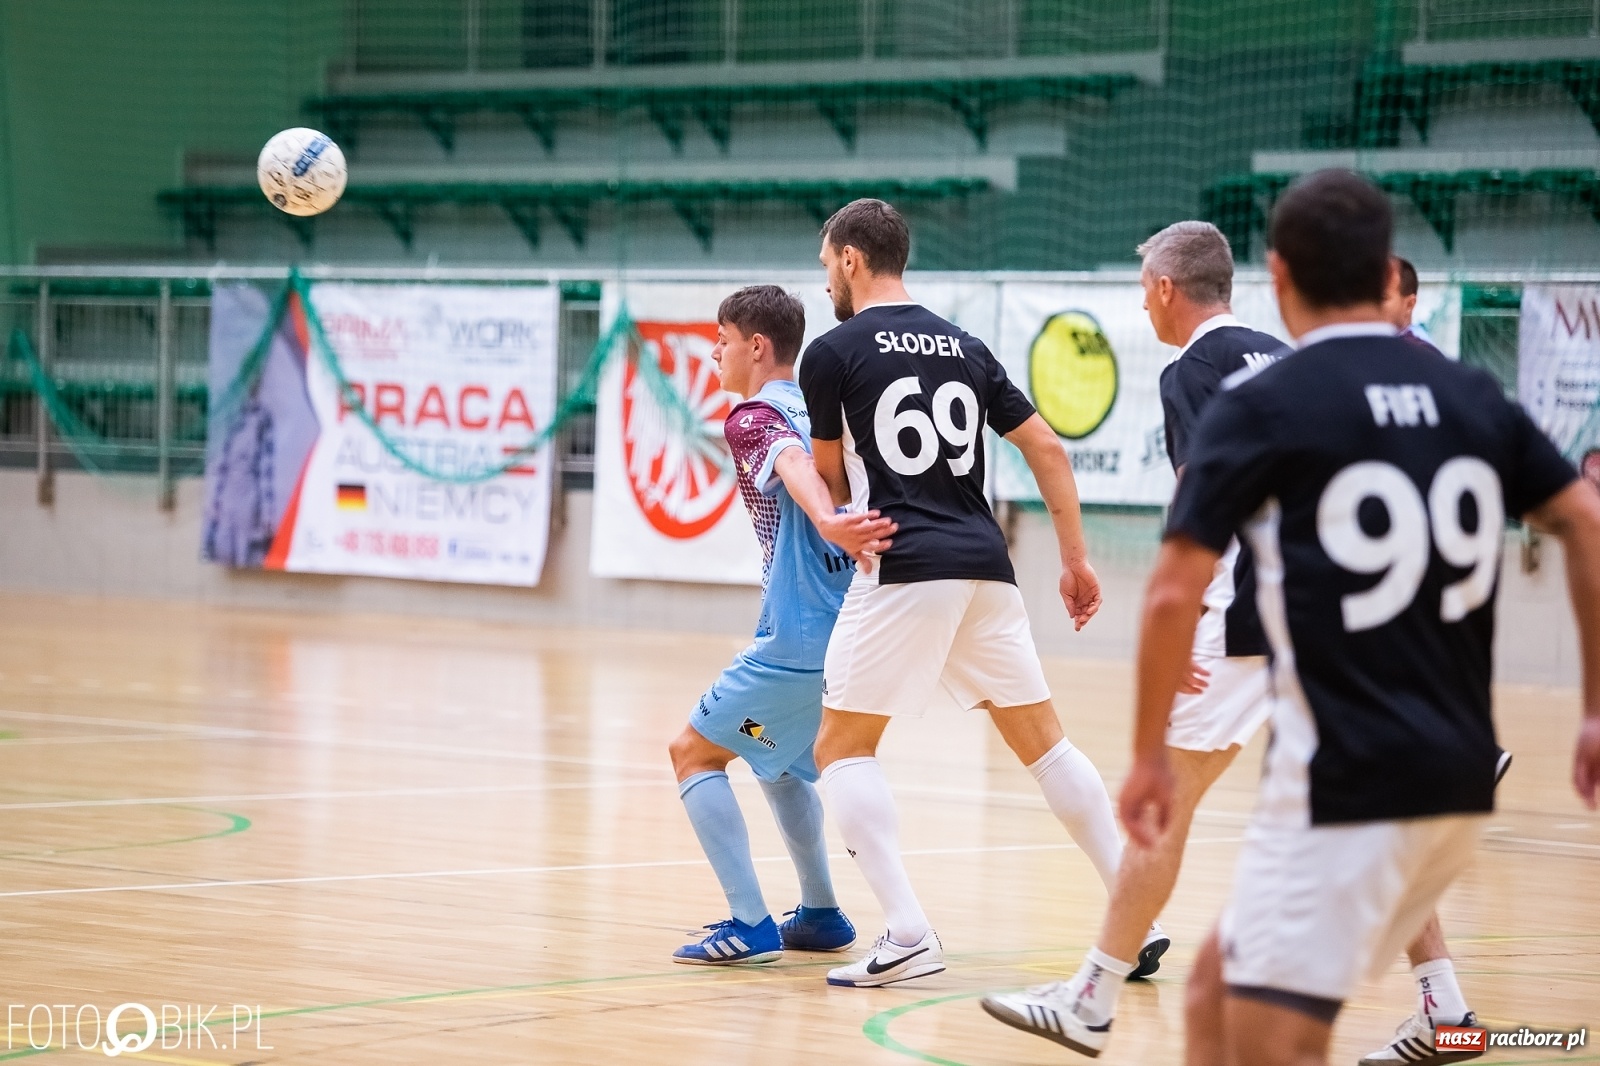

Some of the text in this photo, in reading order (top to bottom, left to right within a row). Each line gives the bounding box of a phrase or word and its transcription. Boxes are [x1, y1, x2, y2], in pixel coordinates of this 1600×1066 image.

[874, 331, 966, 359] SŁODEK
[336, 381, 536, 432] PRACA
[874, 376, 979, 477] 69
[1364, 384, 1440, 428] FIFI
[373, 483, 537, 524] NIEMCY
[1315, 454, 1506, 634] 99
